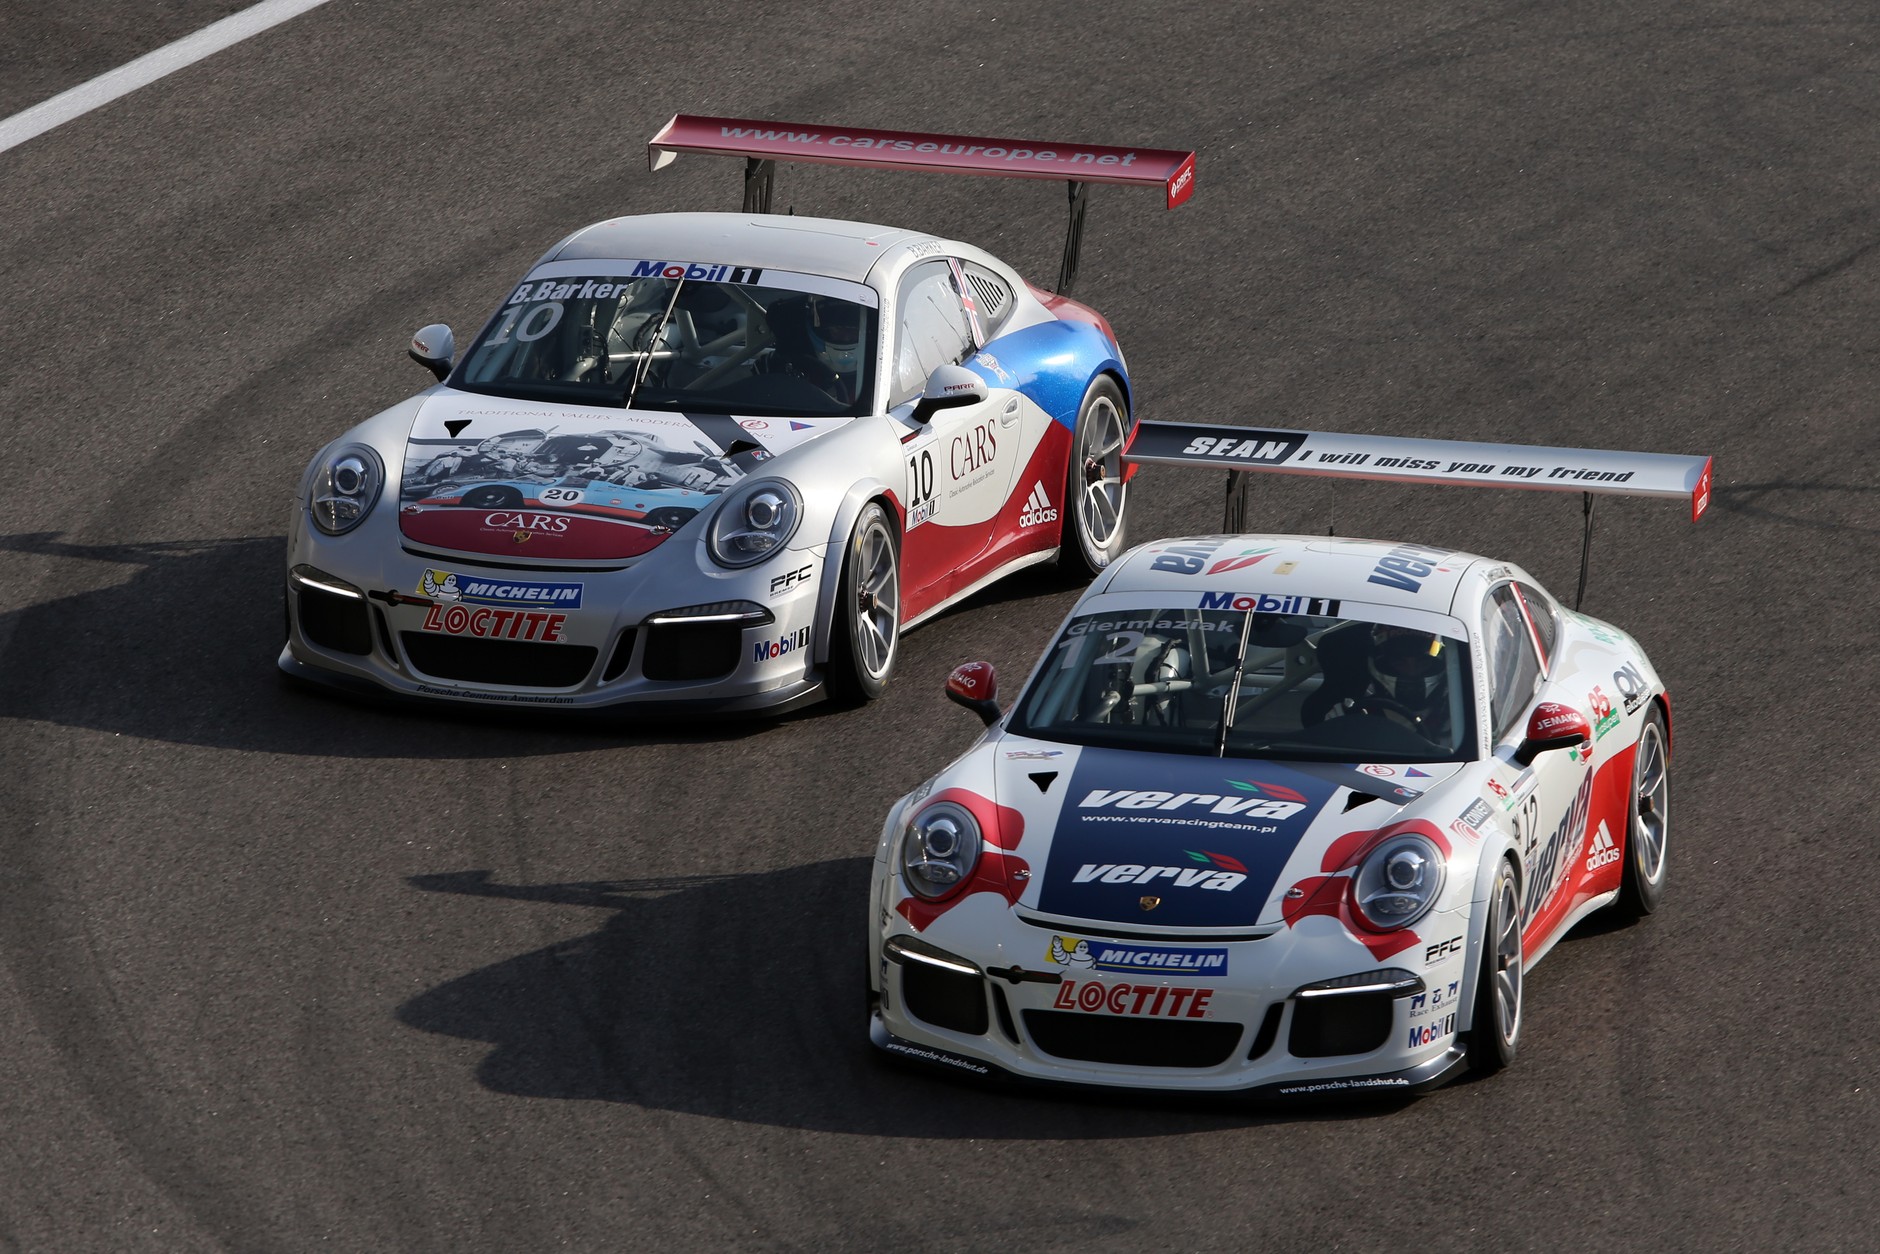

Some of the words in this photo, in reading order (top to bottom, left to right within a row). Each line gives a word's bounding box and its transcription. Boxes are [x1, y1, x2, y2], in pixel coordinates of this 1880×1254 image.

[720, 126, 1137, 168] www.carseurope.net
[631, 261, 728, 282] Mobil
[508, 280, 631, 304] B.Barker
[484, 302, 564, 347] 10
[944, 383, 975, 391] PARR
[951, 419, 997, 480] CARS
[1183, 436, 1289, 460] SEAN
[1297, 450, 1313, 461] I
[1318, 452, 1371, 465] will
[1374, 455, 1441, 470] miss
[1442, 461, 1496, 474] you
[1500, 466, 1543, 479] my
[1548, 467, 1636, 483] friend
[909, 450, 933, 508] 10
[544, 489, 579, 501] 20
[484, 512, 571, 532] CARS
[1019, 507, 1058, 529] adidas
[465, 582, 580, 600] MICHELIN
[770, 564, 813, 593] PFC
[1198, 592, 1302, 614] Mobil
[422, 603, 567, 643] LOCTITE
[1067, 619, 1235, 635] Giermaziak
[754, 631, 797, 663] Mobil
[1059, 631, 1145, 670] 12
[416, 684, 460, 697] Porsche
[462, 691, 508, 702] Centrum
[510, 694, 574, 704] Amsterdam
[1588, 685, 1611, 724] 95
[1537, 712, 1581, 730] JEMAKO
[1078, 789, 1307, 820] verva
[1081, 815, 1278, 833] www.vervaracingteam.pl
[1523, 794, 1538, 857] 12
[1586, 847, 1620, 872] adidas
[1072, 864, 1248, 892] verva
[1099, 949, 1225, 967] MICHELIN
[1425, 935, 1463, 961] PFC
[1053, 980, 1214, 1018] LOCTITE
[1409, 1007, 1429, 1018] Race
[1408, 1016, 1446, 1049] Mobil
[886, 1042, 988, 1075] www.porsche-landshut.de
[1280, 1078, 1409, 1094] www.porsche-landshut.de
